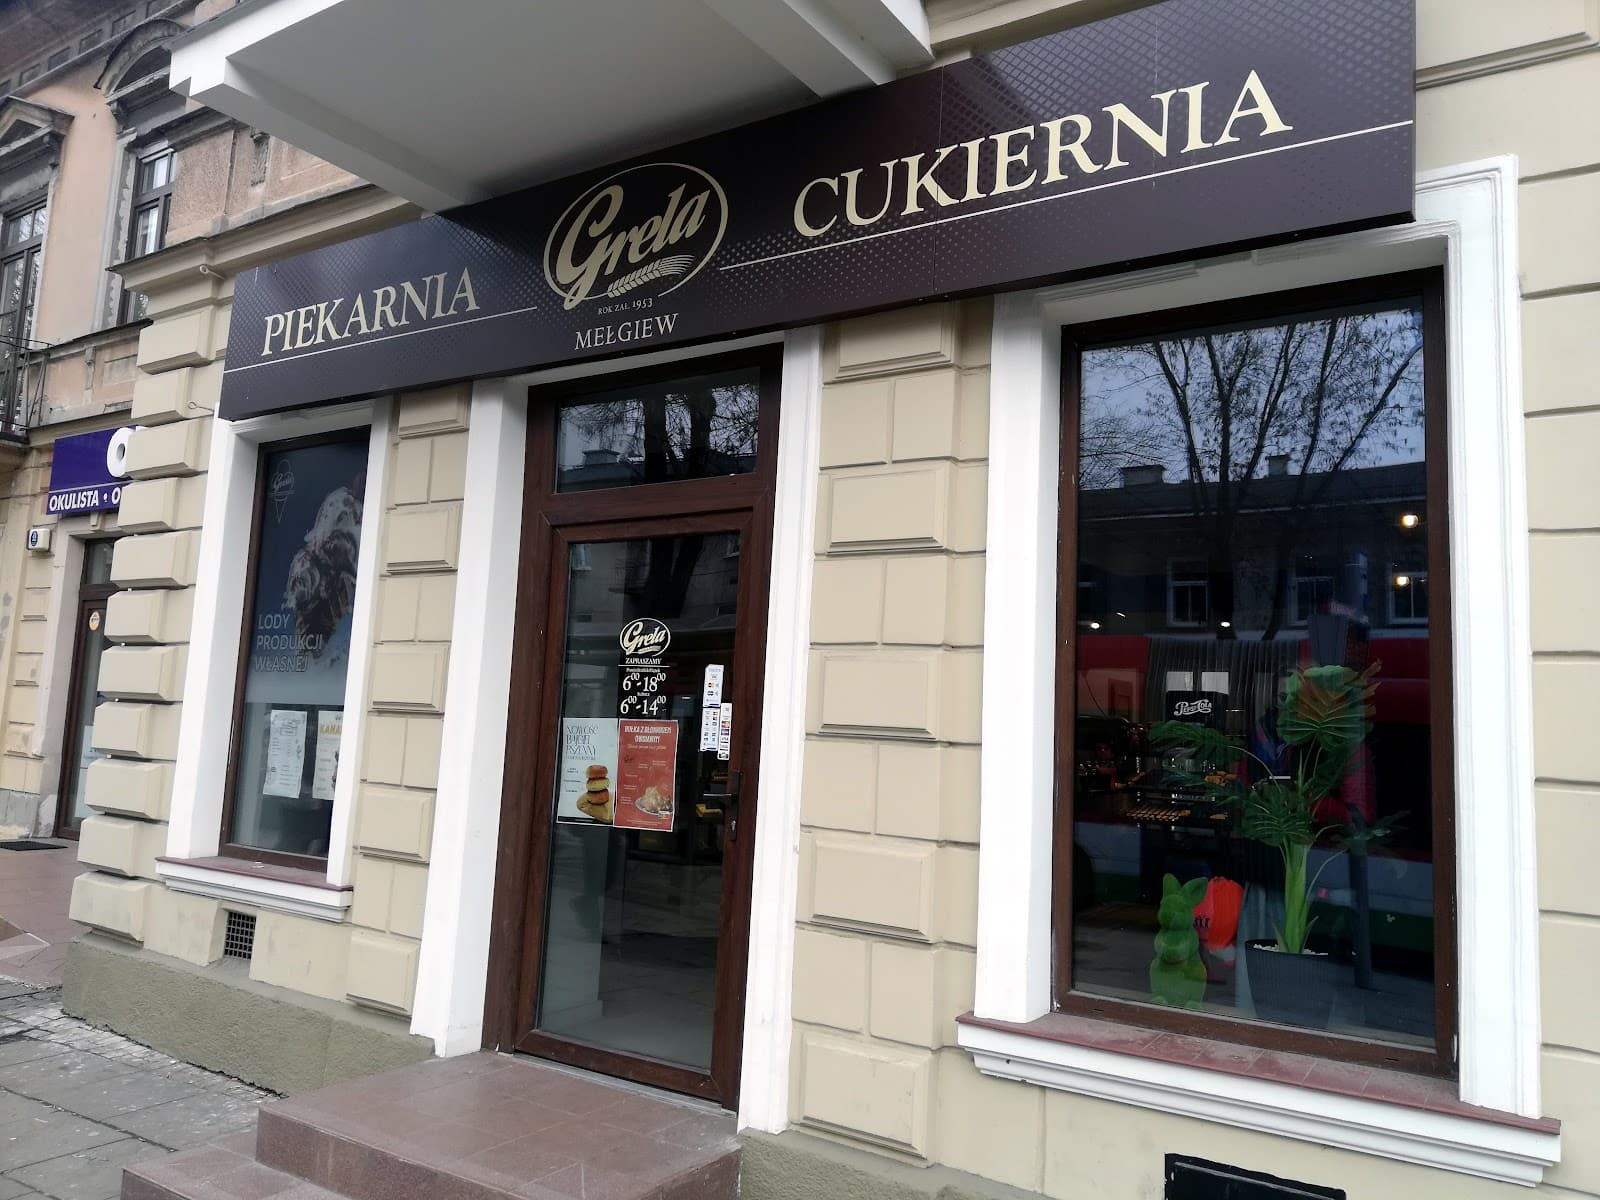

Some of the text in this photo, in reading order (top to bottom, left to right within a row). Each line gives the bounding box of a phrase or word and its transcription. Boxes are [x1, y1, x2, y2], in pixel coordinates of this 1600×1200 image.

[793, 69, 1294, 237] CUKIERNIA
[555, 183, 712, 310] Grela
[261, 267, 480, 357] PIEKARNIA
[598, 305, 613, 315] ROK
[632, 298, 653, 310] 1953
[574, 313, 679, 350] MEŁGIEW
[49, 489, 99, 512] OKULISTA
[258, 614, 290, 630] LODY
[256, 633, 323, 650] PRODUKCJI
[623, 621, 666, 655] Grela
[255, 655, 309, 672] WŁASNEJ
